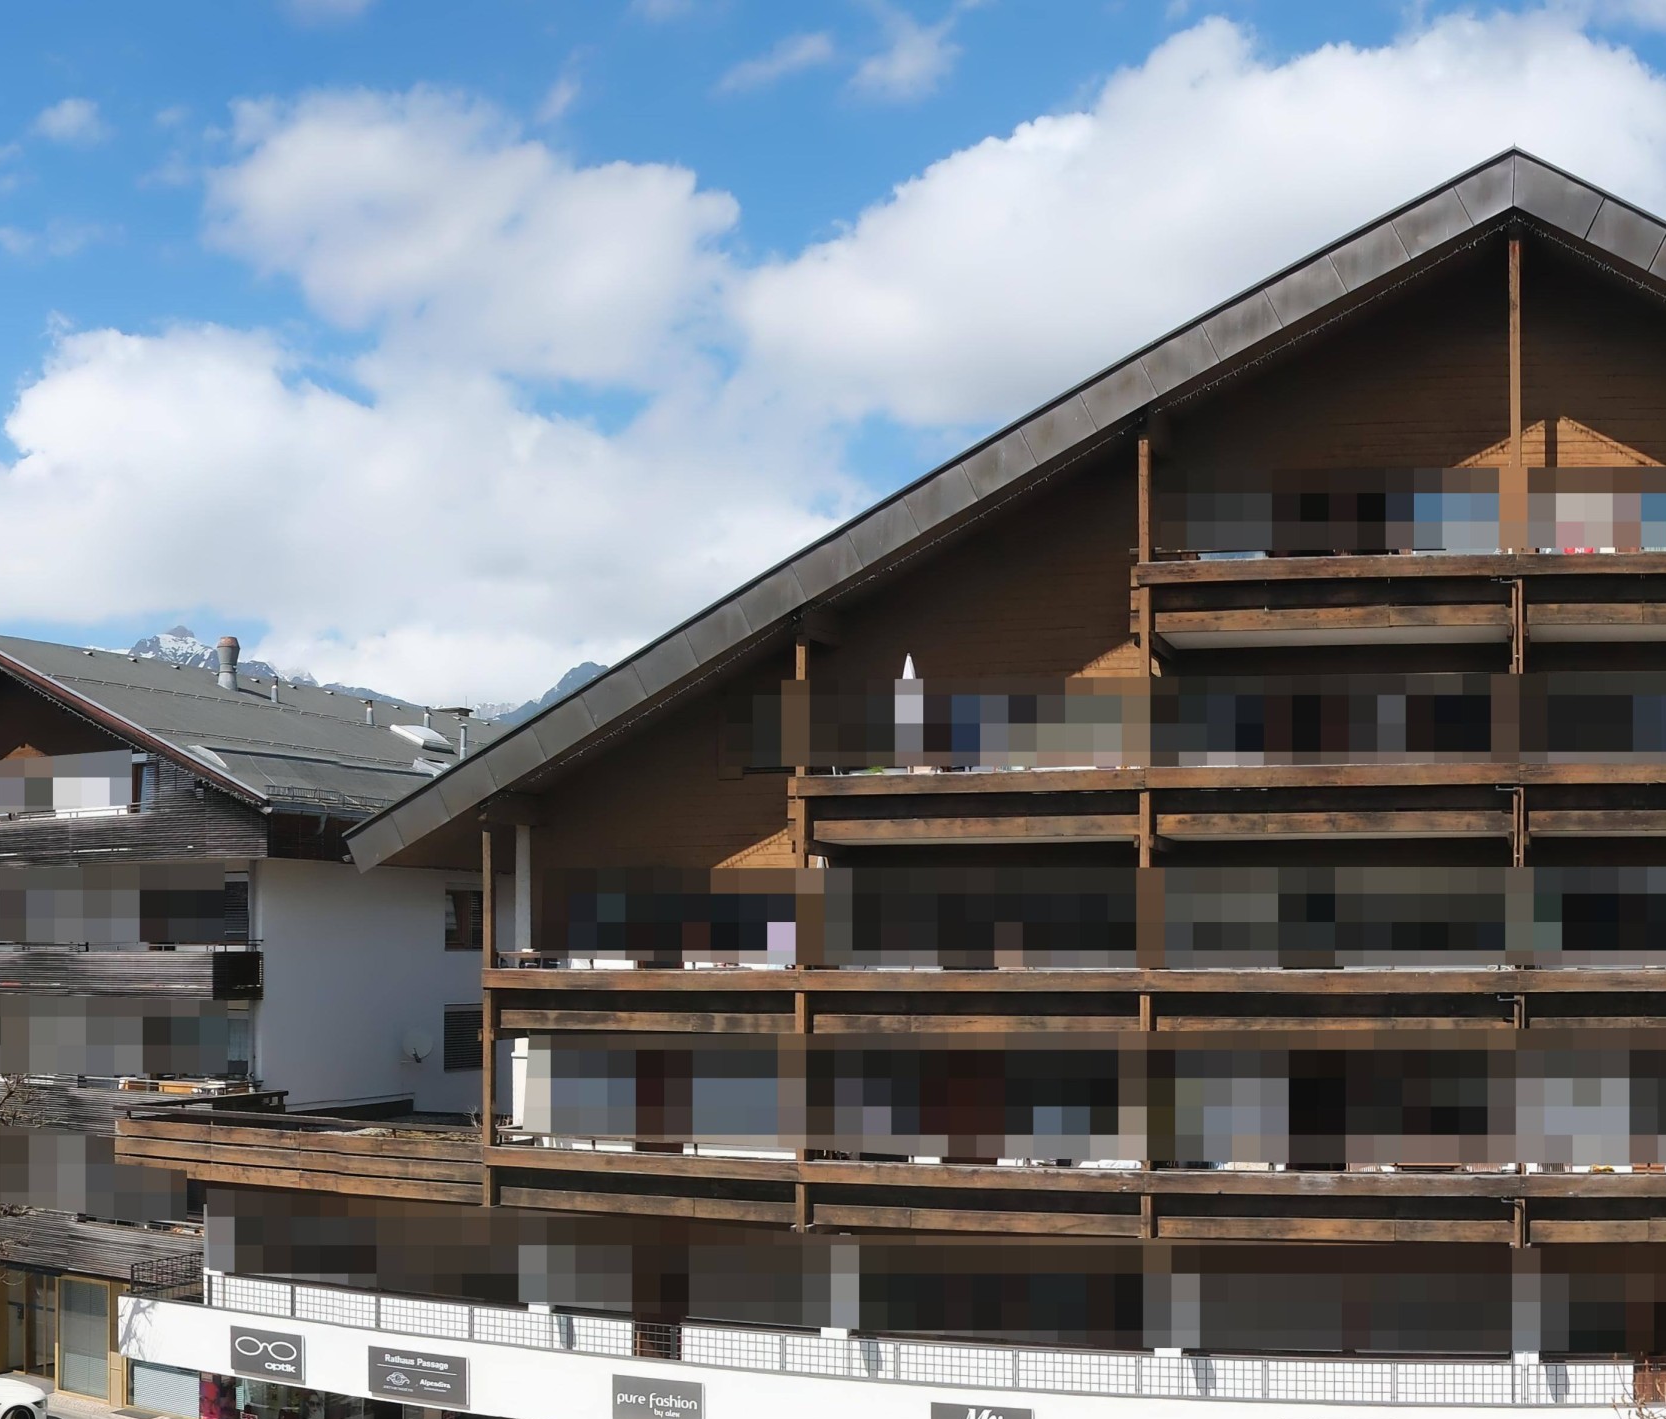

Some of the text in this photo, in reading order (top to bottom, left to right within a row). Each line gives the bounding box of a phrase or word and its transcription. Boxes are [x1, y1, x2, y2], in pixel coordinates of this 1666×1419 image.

[264, 1361, 297, 1374] optik
[384, 1353, 449, 1371] Rathaus Passage
[616, 1392, 698, 1410] pure fashion
[653, 1407, 664, 1418] by
